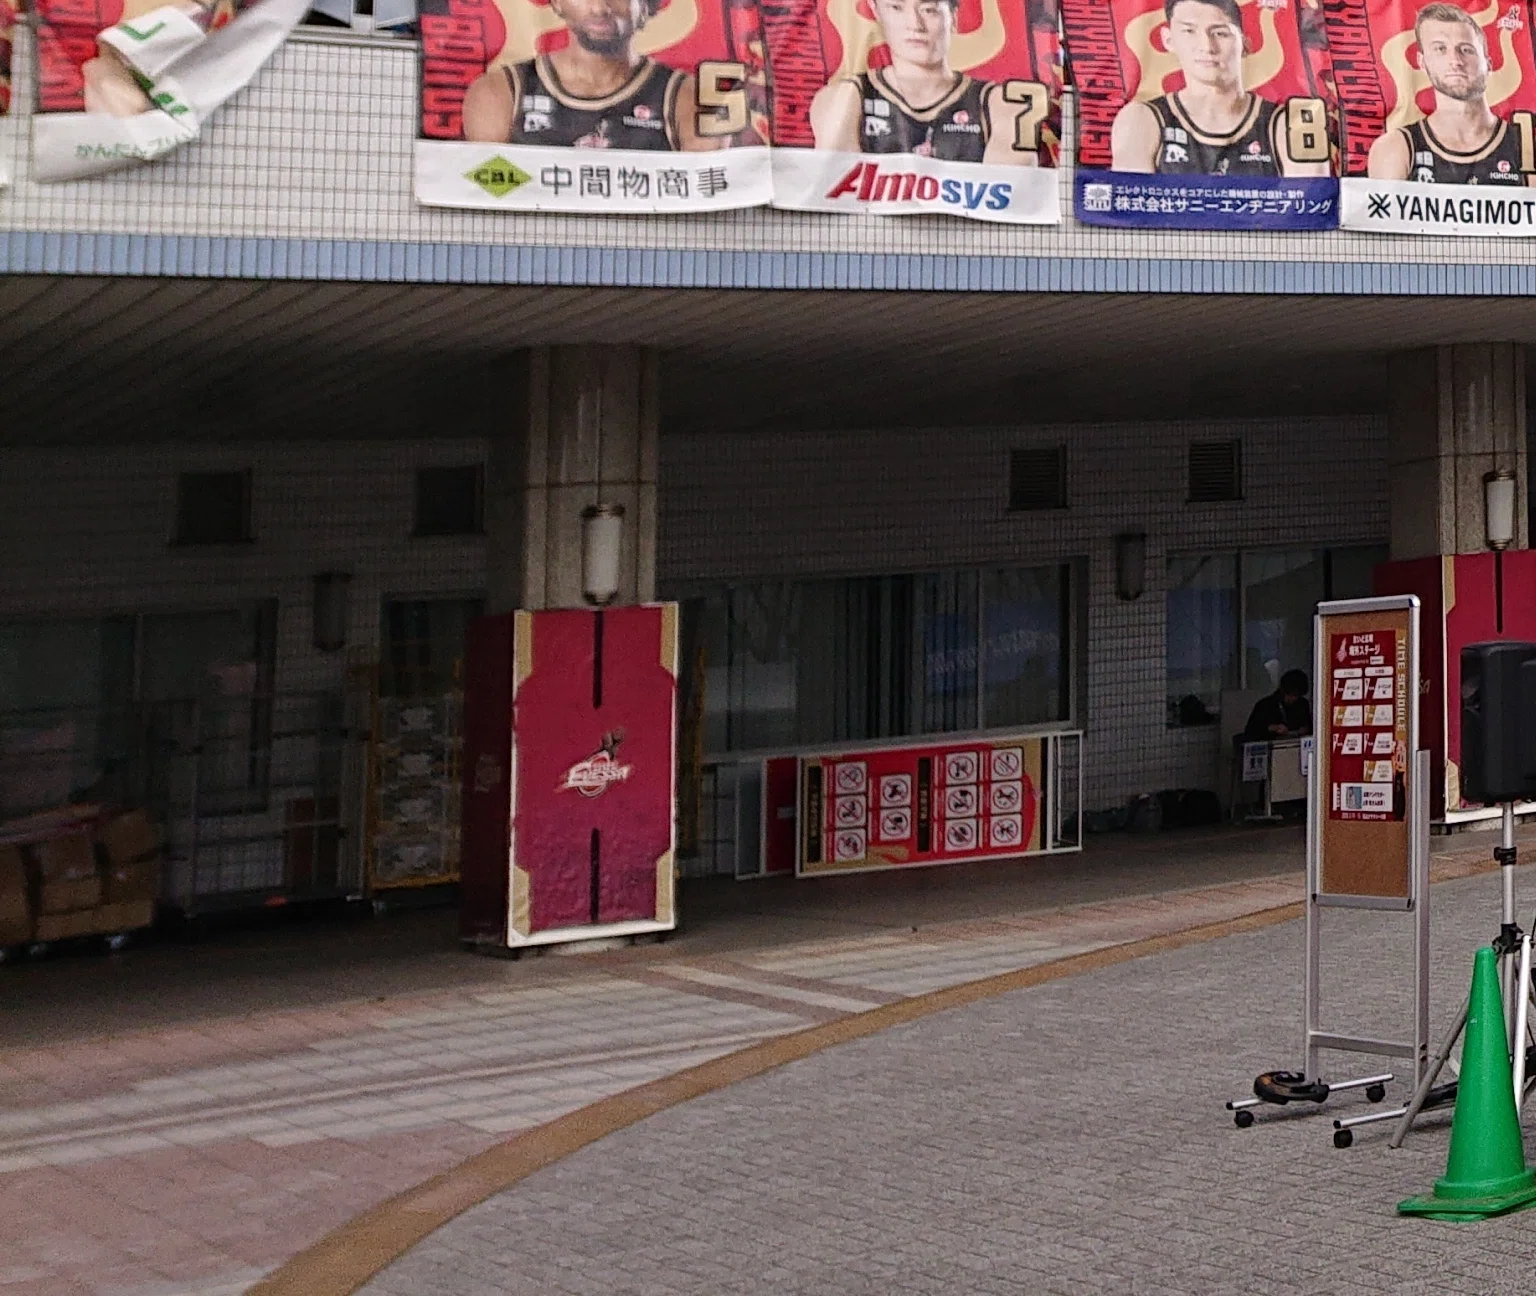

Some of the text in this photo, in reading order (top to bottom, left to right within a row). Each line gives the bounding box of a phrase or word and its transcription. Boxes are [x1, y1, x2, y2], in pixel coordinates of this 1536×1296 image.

[697, 60, 749, 137] 5
[1001, 80, 1049, 152] 7
[1286, 97, 1331, 162] 8
[539, 164, 730, 199] 中間物商事
[826, 161, 1013, 213] Amosys
[1396, 636, 1407, 670] TIME
